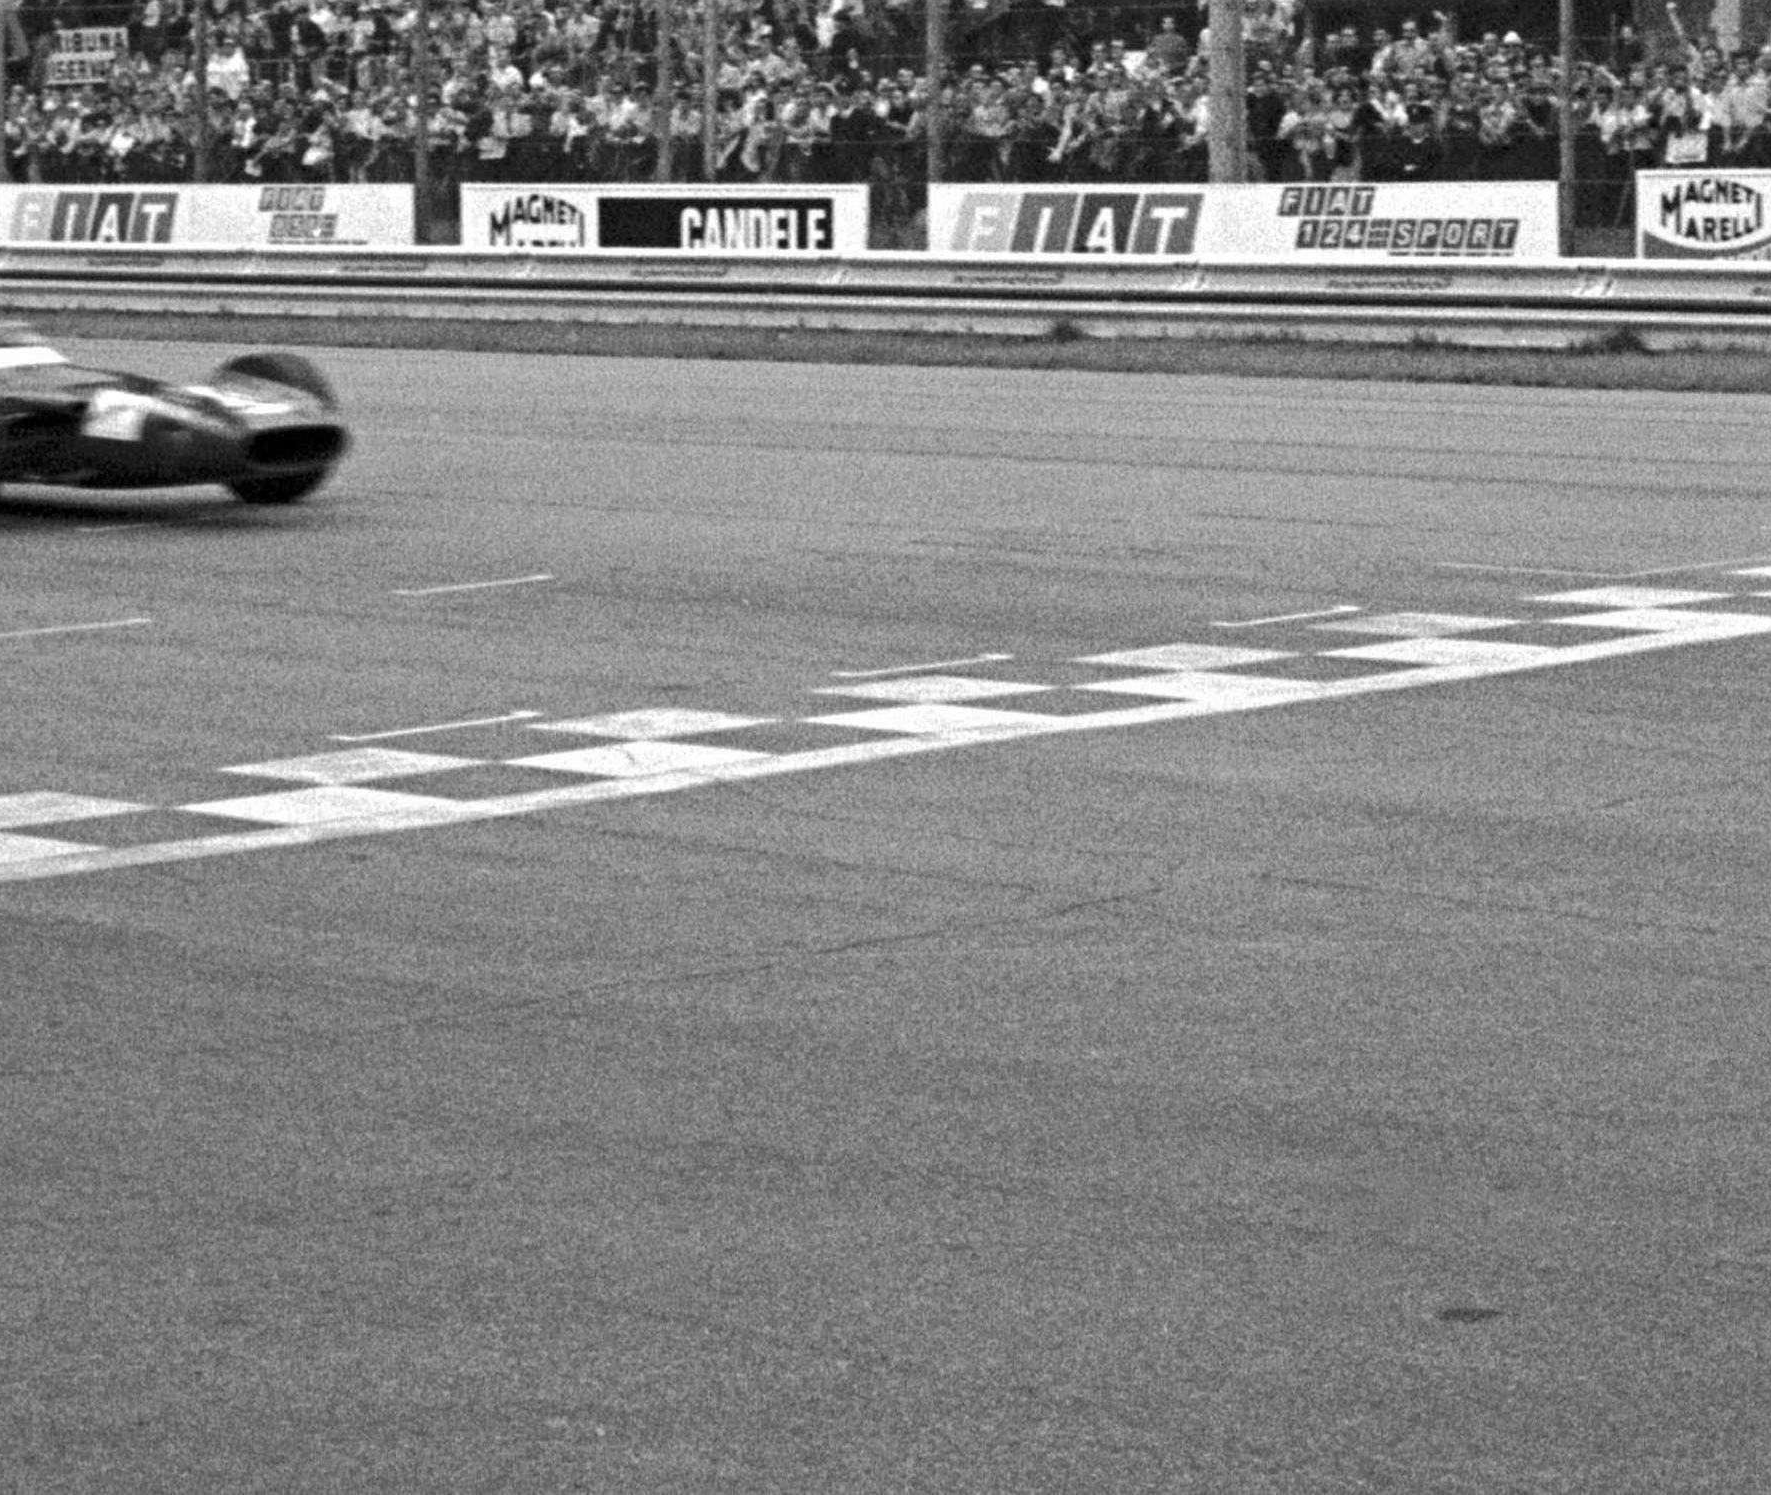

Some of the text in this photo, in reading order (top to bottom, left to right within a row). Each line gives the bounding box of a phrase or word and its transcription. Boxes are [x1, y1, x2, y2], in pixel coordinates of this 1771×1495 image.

[1279, 186, 1374, 216] FIAT
[1661, 179, 1762, 213] MAGNETI
[20, 201, 171, 243] FIAT
[680, 207, 827, 249] CANDELE
[966, 203, 1192, 253] FIAT
[1393, 220, 1518, 249] SPORT
